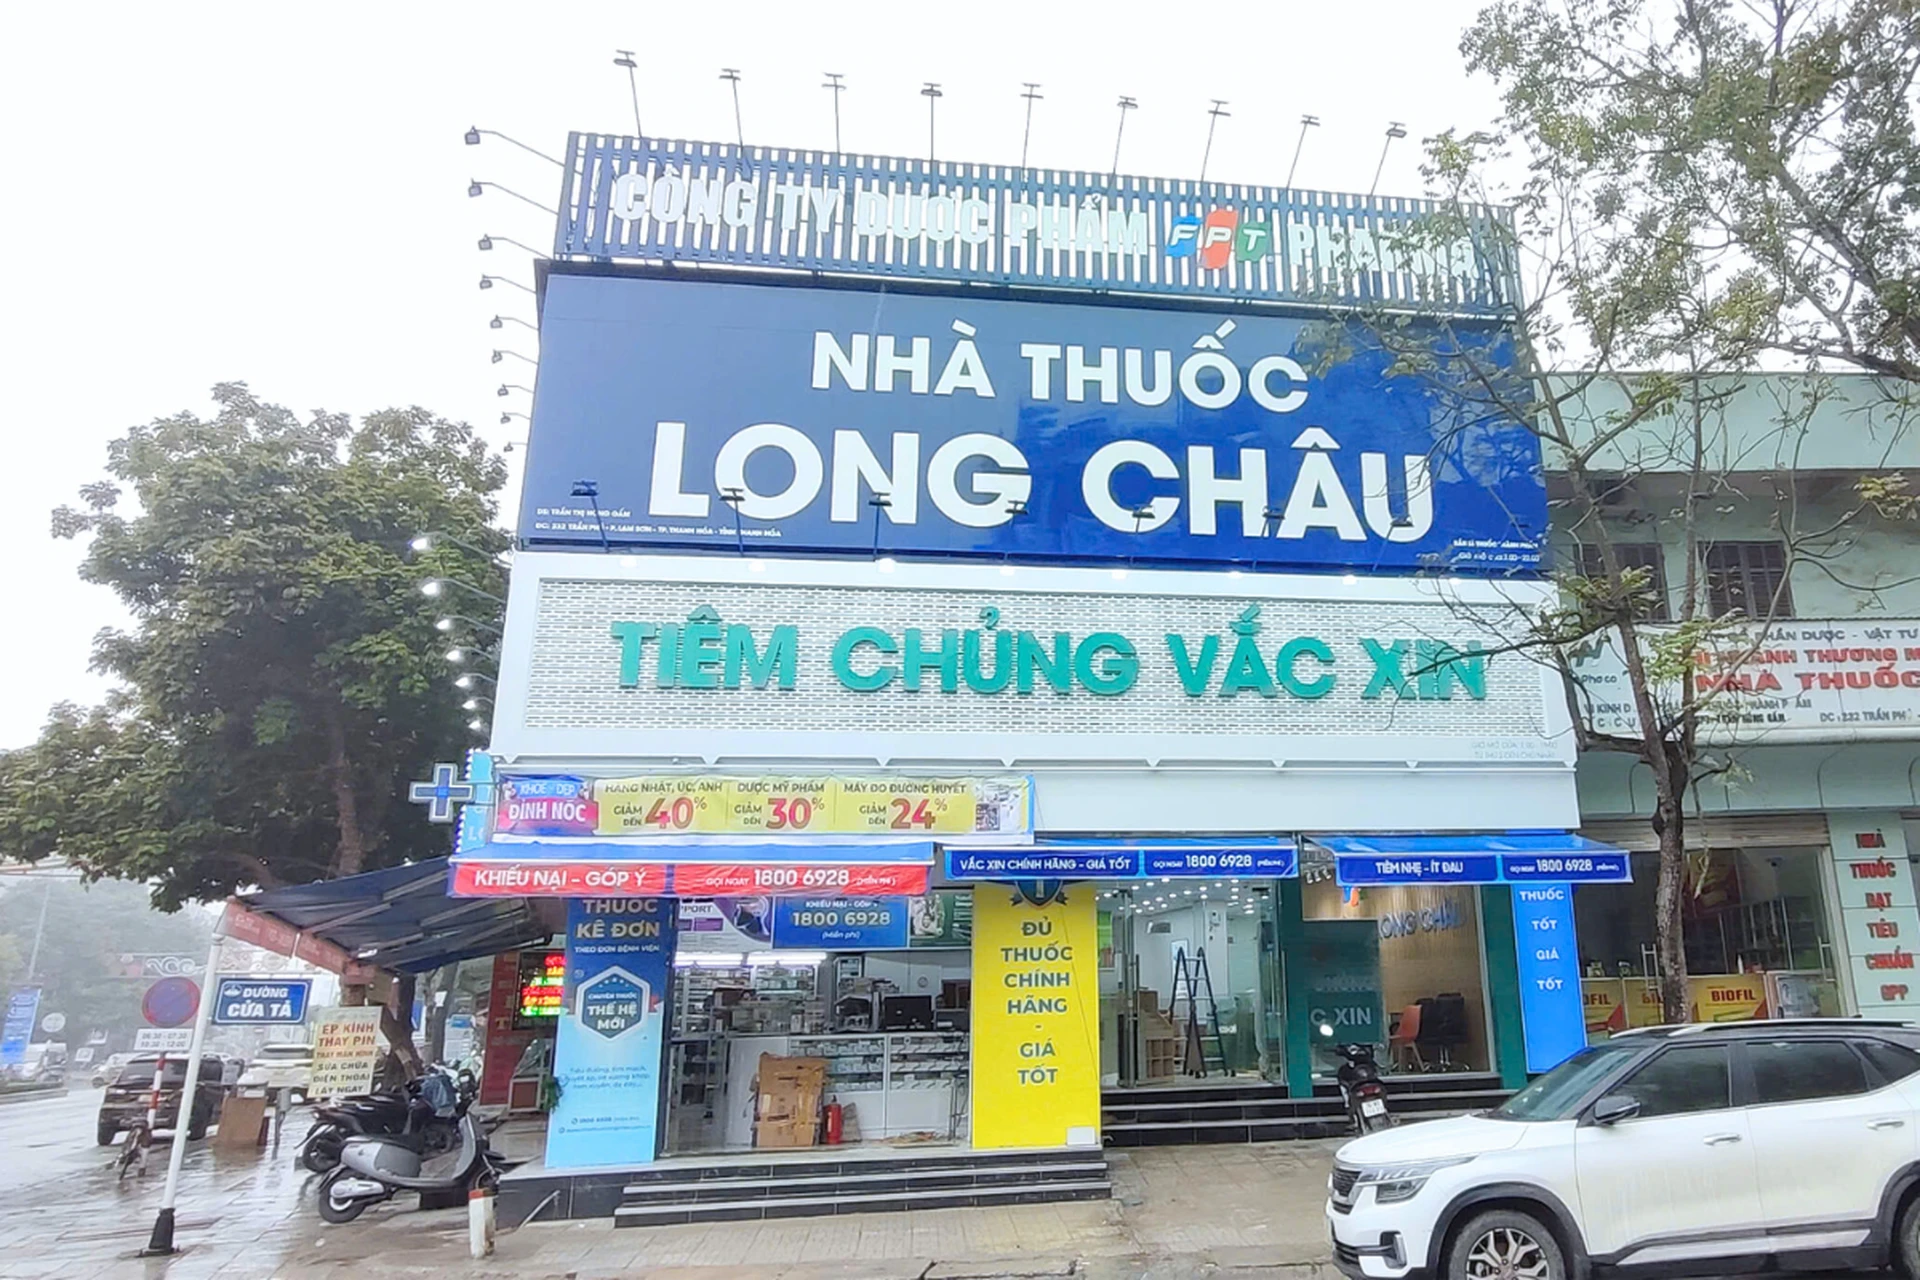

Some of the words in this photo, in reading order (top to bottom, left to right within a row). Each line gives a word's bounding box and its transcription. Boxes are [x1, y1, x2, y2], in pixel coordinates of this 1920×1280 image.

[614, 163, 757, 228] CÔNG
[776, 184, 840, 233] TY
[857, 190, 990, 251] DƯỢC
[1009, 193, 1148, 256] PHẨM
[1168, 221, 1269, 254] FPT
[811, 318, 996, 399] NHÀ
[1020, 318, 1309, 413] THUỐC
[648, 421, 1033, 528] LONG
[1081, 425, 1434, 543] CHÂU
[1801, 629, 1846, 643] DƯỢC
[1864, 627, 1893, 642] VẬT
[611, 603, 797, 690] TIÊM
[831, 605, 1141, 696] CHỦNG
[1165, 602, 1336, 699] VẮC
[1360, 637, 1486, 700] XIN
[1803, 647, 1899, 663] THƯƠNG
[1694, 668, 1783, 694] NHÀ
[1793, 661, 1920, 692] THUỐC
[698, 782, 723, 793] ANH
[613, 802, 643, 816] GIẢM
[734, 803, 763, 815] GIẢM
[858, 803, 888, 816] GIẢM
[959, 857, 984, 871] VẮC
[986, 858, 1005, 870] XIN
[1006, 856, 1042, 870] CHÍNH
[1043, 857, 1077, 870] HÃNG
[1085, 856, 1106, 870] GIÁ
[1107, 855, 1132, 870] TỐT
[1185, 854, 1217, 868] 1800
[1219, 854, 1252, 868] 6928
[1441, 861, 1464, 874] ĐAU
[1536, 859, 1562, 873] 1800
[1564, 858, 1593, 872] 6928
[1849, 856, 1897, 879] THUỐC
[474, 864, 531, 887] KHIẾU
[533, 871, 567, 891] NẠI
[585, 866, 630, 887] GÓP
[634, 867, 648, 887] Ý
[753, 869, 798, 887] 1800
[802, 869, 850, 887] 6928
[1519, 886, 1565, 901] THUỐC
[681, 904, 713, 914] PORT
[792, 911, 838, 927] 1800
[844, 911, 891, 926] 6928
[1021, 916, 1052, 936] ĐỦ
[1531, 916, 1558, 930] TỐT
[576, 919, 605, 938] KÊ
[610, 920, 660, 938] ĐƠN
[1000, 942, 1073, 962] THUỐC
[1536, 947, 1559, 961] GIÁ
[1004, 967, 1071, 988] CHÍNH
[1537, 976, 1564, 990] TỐT
[242, 985, 290, 998] ĐƯỜNG
[1711, 988, 1756, 1003] BIOFIL
[226, 999, 265, 1018] CỬA
[270, 1000, 292, 1018] TẢ
[587, 1001, 616, 1016] THẾ
[618, 1004, 638, 1017] HỆ
[1007, 996, 1068, 1015] HÃNG
[596, 1016, 625, 1030] MỚI
[1334, 1006, 1372, 1025] XIN
[318, 1036, 350, 1047] THAY
[352, 1035, 376, 1046] PIN
[1019, 1037, 1056, 1058] GIÁ
[1017, 1063, 1058, 1085] TỐT
[336, 1084, 364, 1093] NGAY
